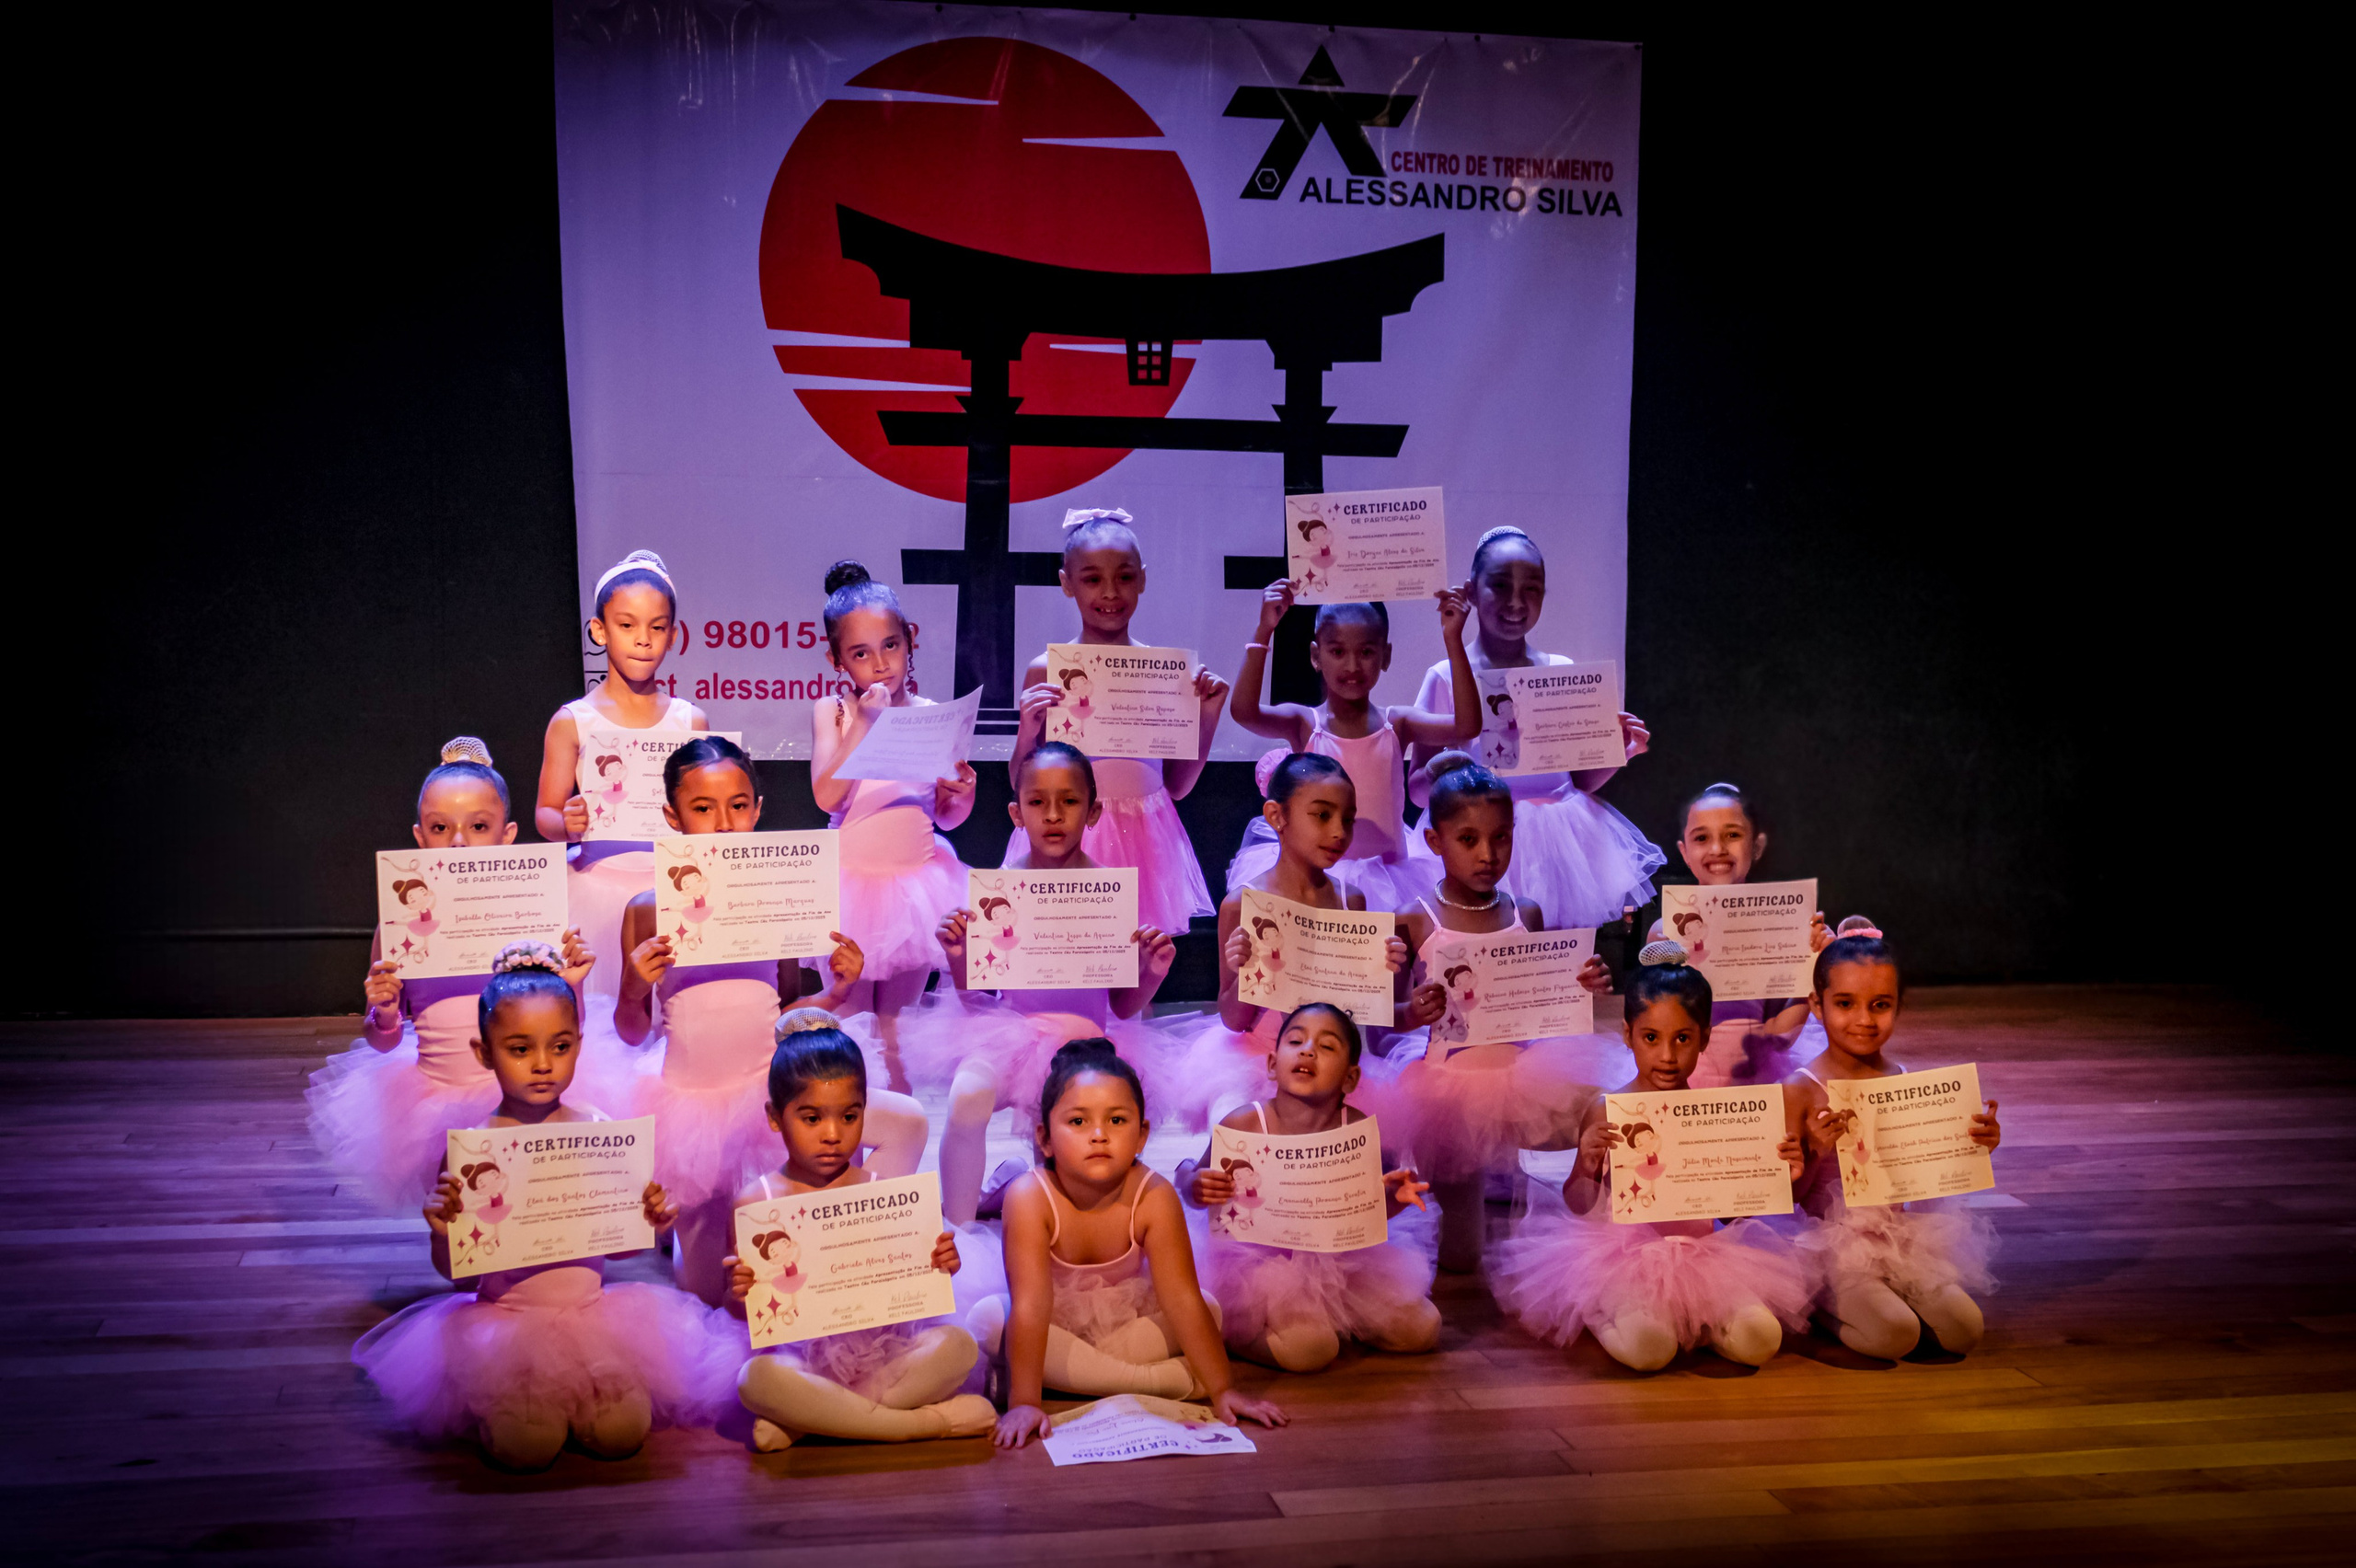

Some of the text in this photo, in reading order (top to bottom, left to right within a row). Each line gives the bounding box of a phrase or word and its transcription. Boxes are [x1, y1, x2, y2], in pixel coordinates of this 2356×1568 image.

[1392, 151, 1613, 182] CENTRO DE TREINAMENTO
[1299, 178, 1623, 217] ALESSANDRO SILVA
[1344, 501, 1426, 515] CERTIFICADO
[1365, 514, 1420, 523] PARTICIPAÇÃO
[1105, 658, 1185, 670] CERTIFICADO
[1125, 672, 1180, 681] PARTICIPAÇÃO
[1528, 674, 1601, 688] CERTIFICADO
[1546, 687, 1597, 697] PARTICIPAÇÃO
[722, 845, 819, 859] CERTIFICADO
[448, 858, 547, 873] CERTIFICADO
[746, 860, 812, 869] PARTICIPAÇÃO
[474, 874, 539, 883] PARTICIPAÇÃO
[1030, 882, 1121, 894] CERTIFICADO
[1052, 896, 1114, 905] PARTICIPAÇÃO
[1722, 894, 1803, 908] CERTIFICADO
[1740, 909, 1796, 917] PARTICIPAÇÃO
[1295, 916, 1377, 935] CERTIFICADO
[1311, 933, 1369, 946] PARTICIPAÇÃO
[1491, 940, 1577, 958] CERTIFICADO
[1511, 952, 1569, 964] PARTICIPAÇÃO
[1868, 1080, 1960, 1104] CERTIFICADO
[1673, 1101, 1767, 1116] CERTIFICADO
[1892, 1097, 1956, 1112] PARTICIPAÇÃO
[1697, 1116, 1760, 1125] PARTICIPAÇÃO
[525, 1135, 635, 1153] CERTIFICADO
[1276, 1136, 1366, 1159] CERTIFICADO
[533, 1151, 626, 1165] DE PARTICIPAÇÃO
[1299, 1153, 1361, 1169] PARTICIPAÇÃO
[812, 1192, 919, 1220] CERTIFICADO
[822, 1210, 912, 1231] DE PARTICIPAÇÃO
[1072, 1441, 1178, 1458] CERTIFICADO
